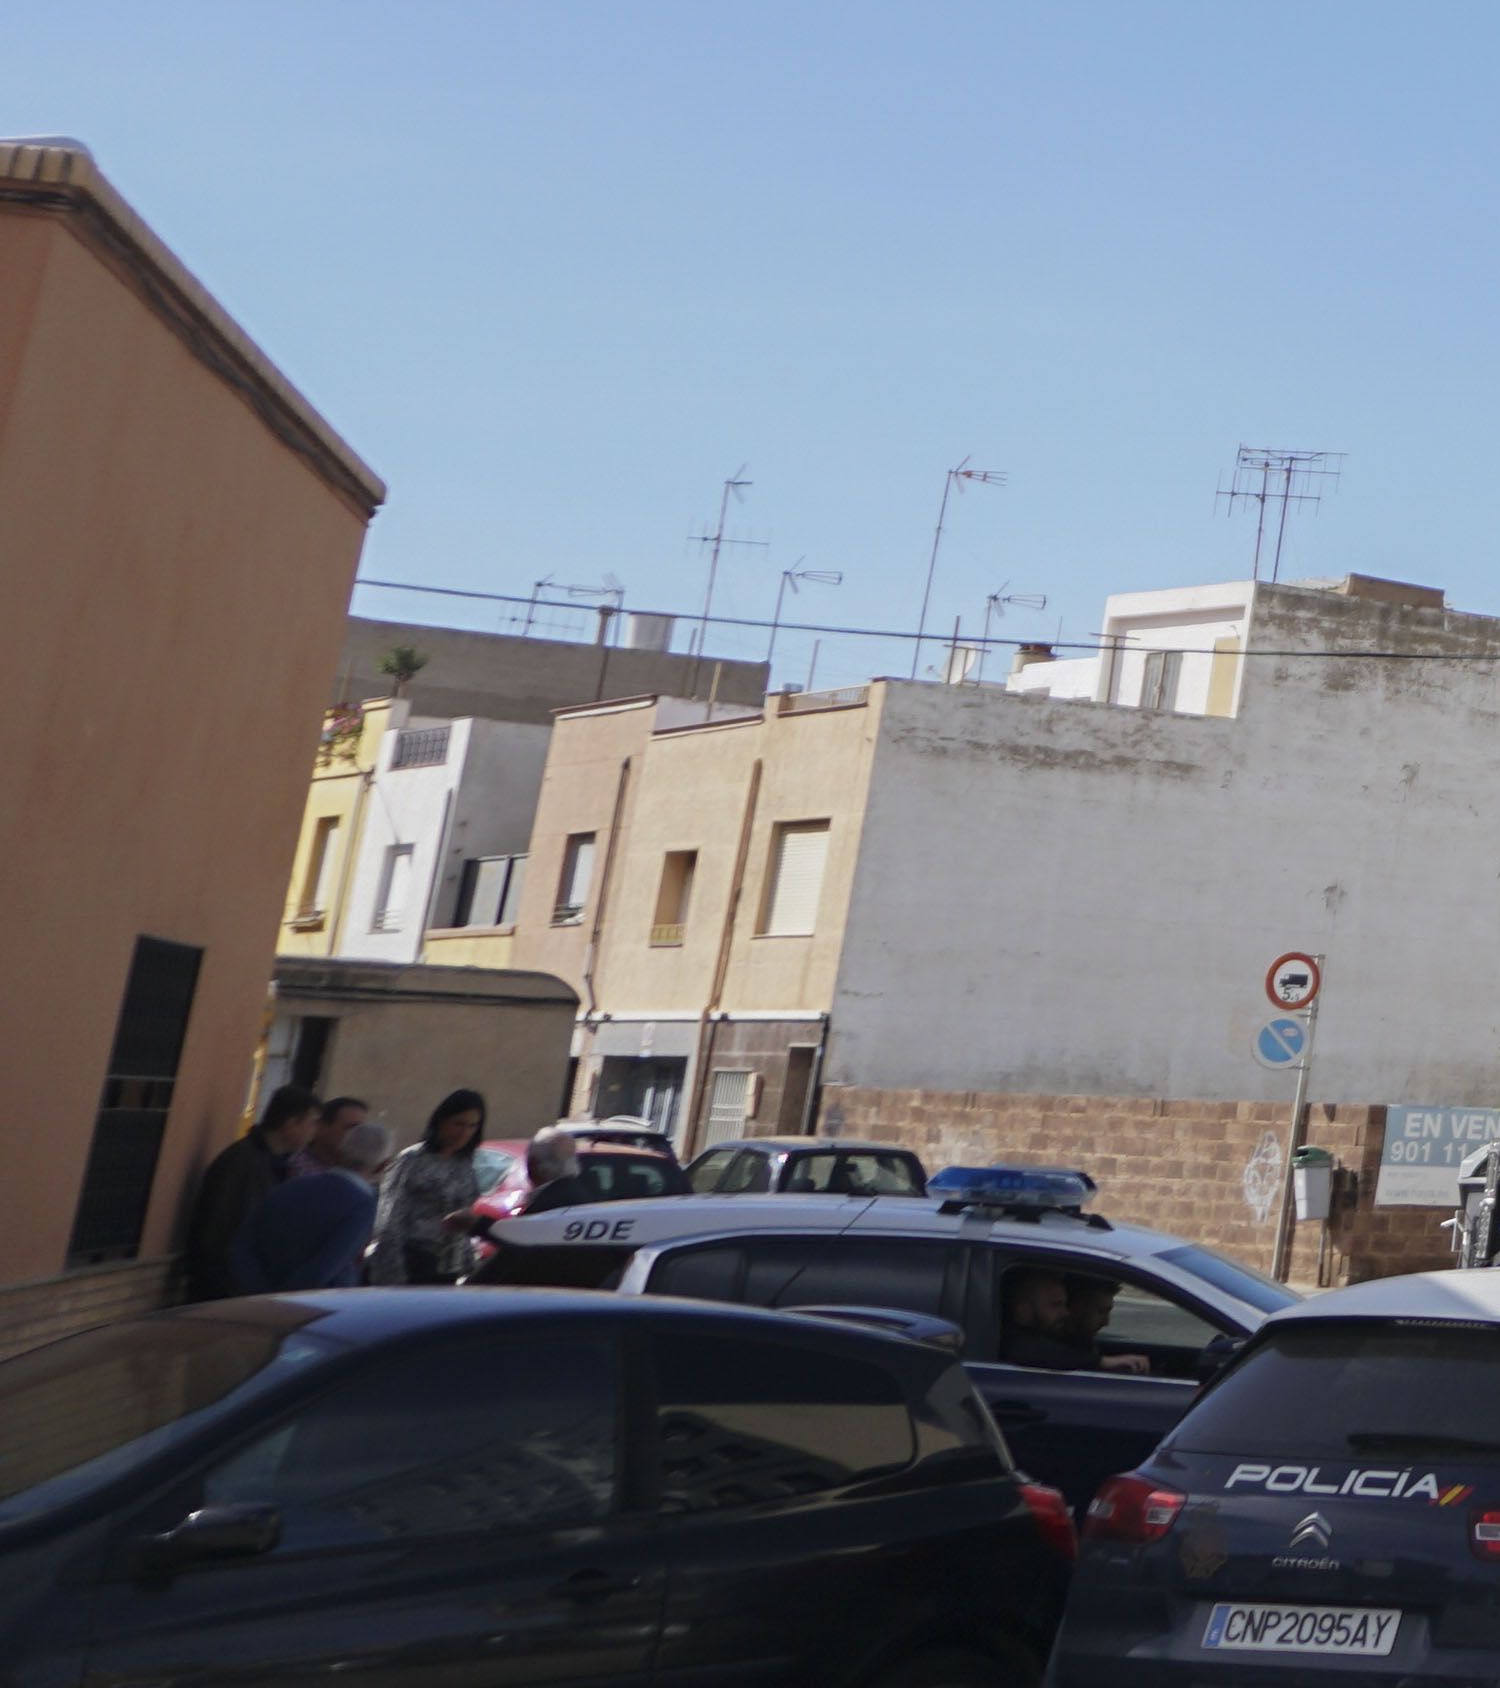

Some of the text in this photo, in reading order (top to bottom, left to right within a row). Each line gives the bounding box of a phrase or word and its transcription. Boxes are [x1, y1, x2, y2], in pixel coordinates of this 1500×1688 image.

[1404, 1113, 1441, 1139] EN
[1390, 1140, 1432, 1162] 901
[563, 1219, 636, 1242] 9DE
[1224, 1464, 1440, 1500] POLICÍA
[1224, 1609, 1393, 1650] CNP2095AY
